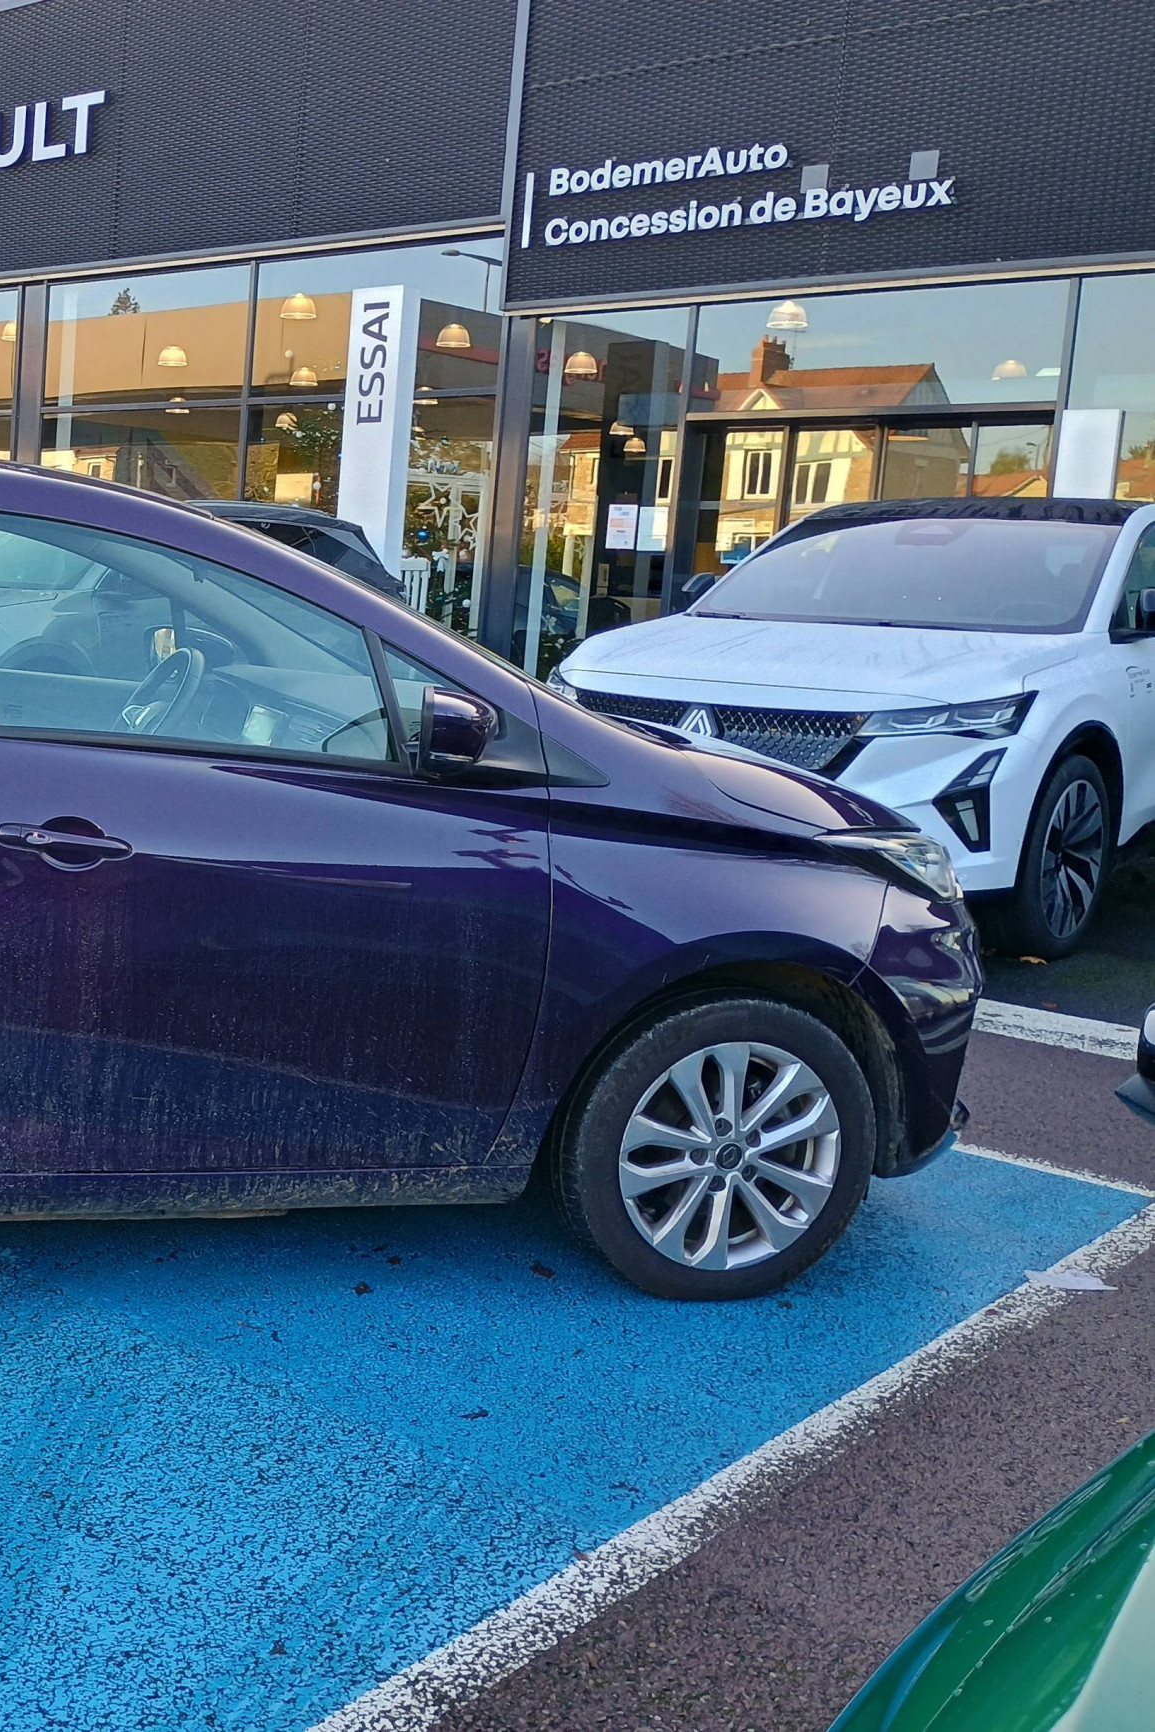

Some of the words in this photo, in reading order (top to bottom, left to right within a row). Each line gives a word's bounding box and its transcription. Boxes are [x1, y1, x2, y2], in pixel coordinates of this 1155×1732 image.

[548, 142, 789, 197] BodemerAuto
[544, 198, 744, 247] Concession
[749, 191, 798, 225] de
[803, 176, 954, 222] Bayeux
[356, 301, 390, 425] ESSAI
